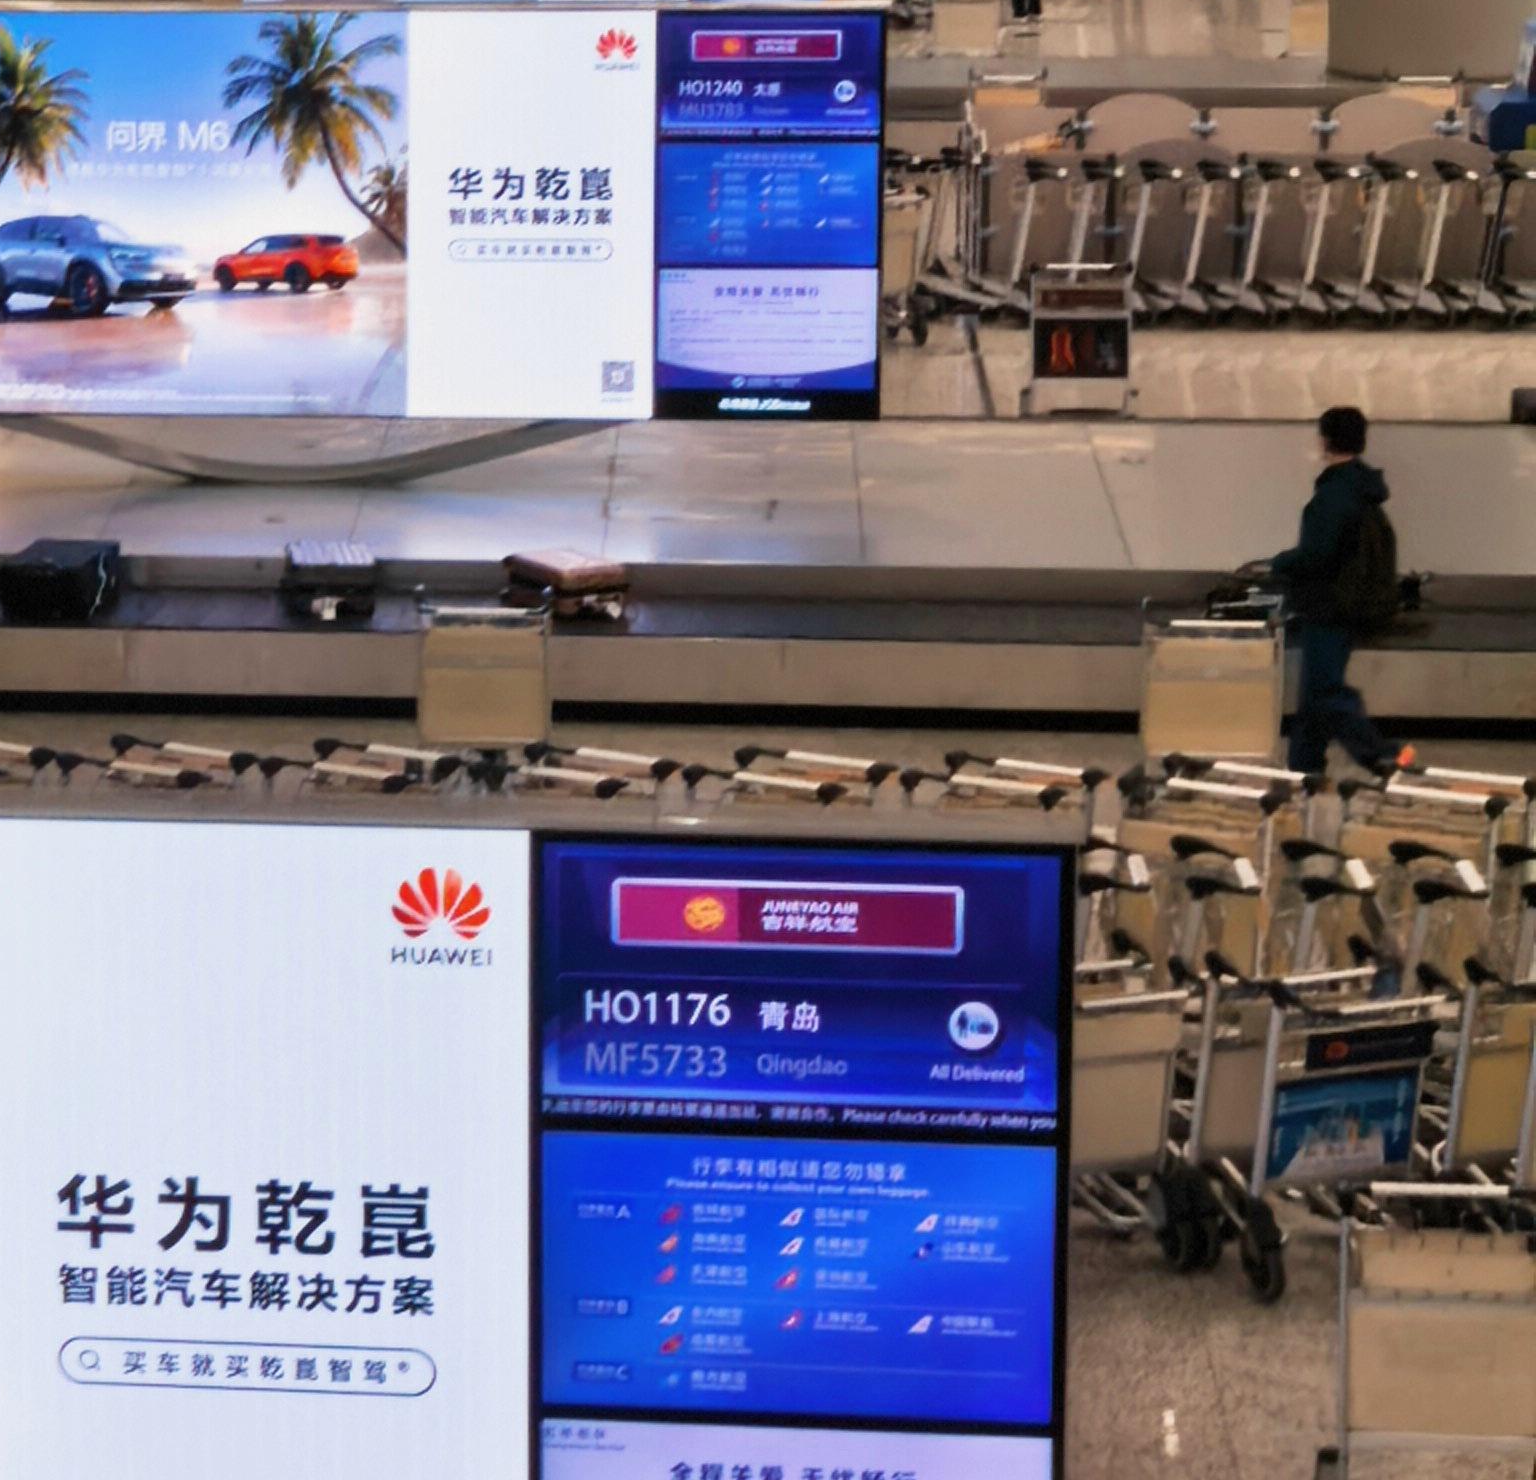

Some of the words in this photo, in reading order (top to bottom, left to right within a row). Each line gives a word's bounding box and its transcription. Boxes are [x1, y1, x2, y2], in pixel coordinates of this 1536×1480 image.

[679, 80, 743, 97] HO1240
[106, 120, 168, 153] 问界
[178, 120, 230, 152] M6
[449, 167, 613, 201] 华为乾崑
[833, 902, 859, 915] AIR
[390, 946, 494, 967] HUAWEI
[584, 990, 731, 1026] HO1176
[759, 1001, 821, 1033] 青岛
[584, 1042, 727, 1077] MF5733
[757, 1053, 847, 1078] Qingdao
[930, 1064, 950, 1081] All
[952, 1065, 1025, 1084] Delivered
[56, 1173, 436, 1260] 华为乾崑
[57, 1263, 436, 1317] 智能汽车解决方案
